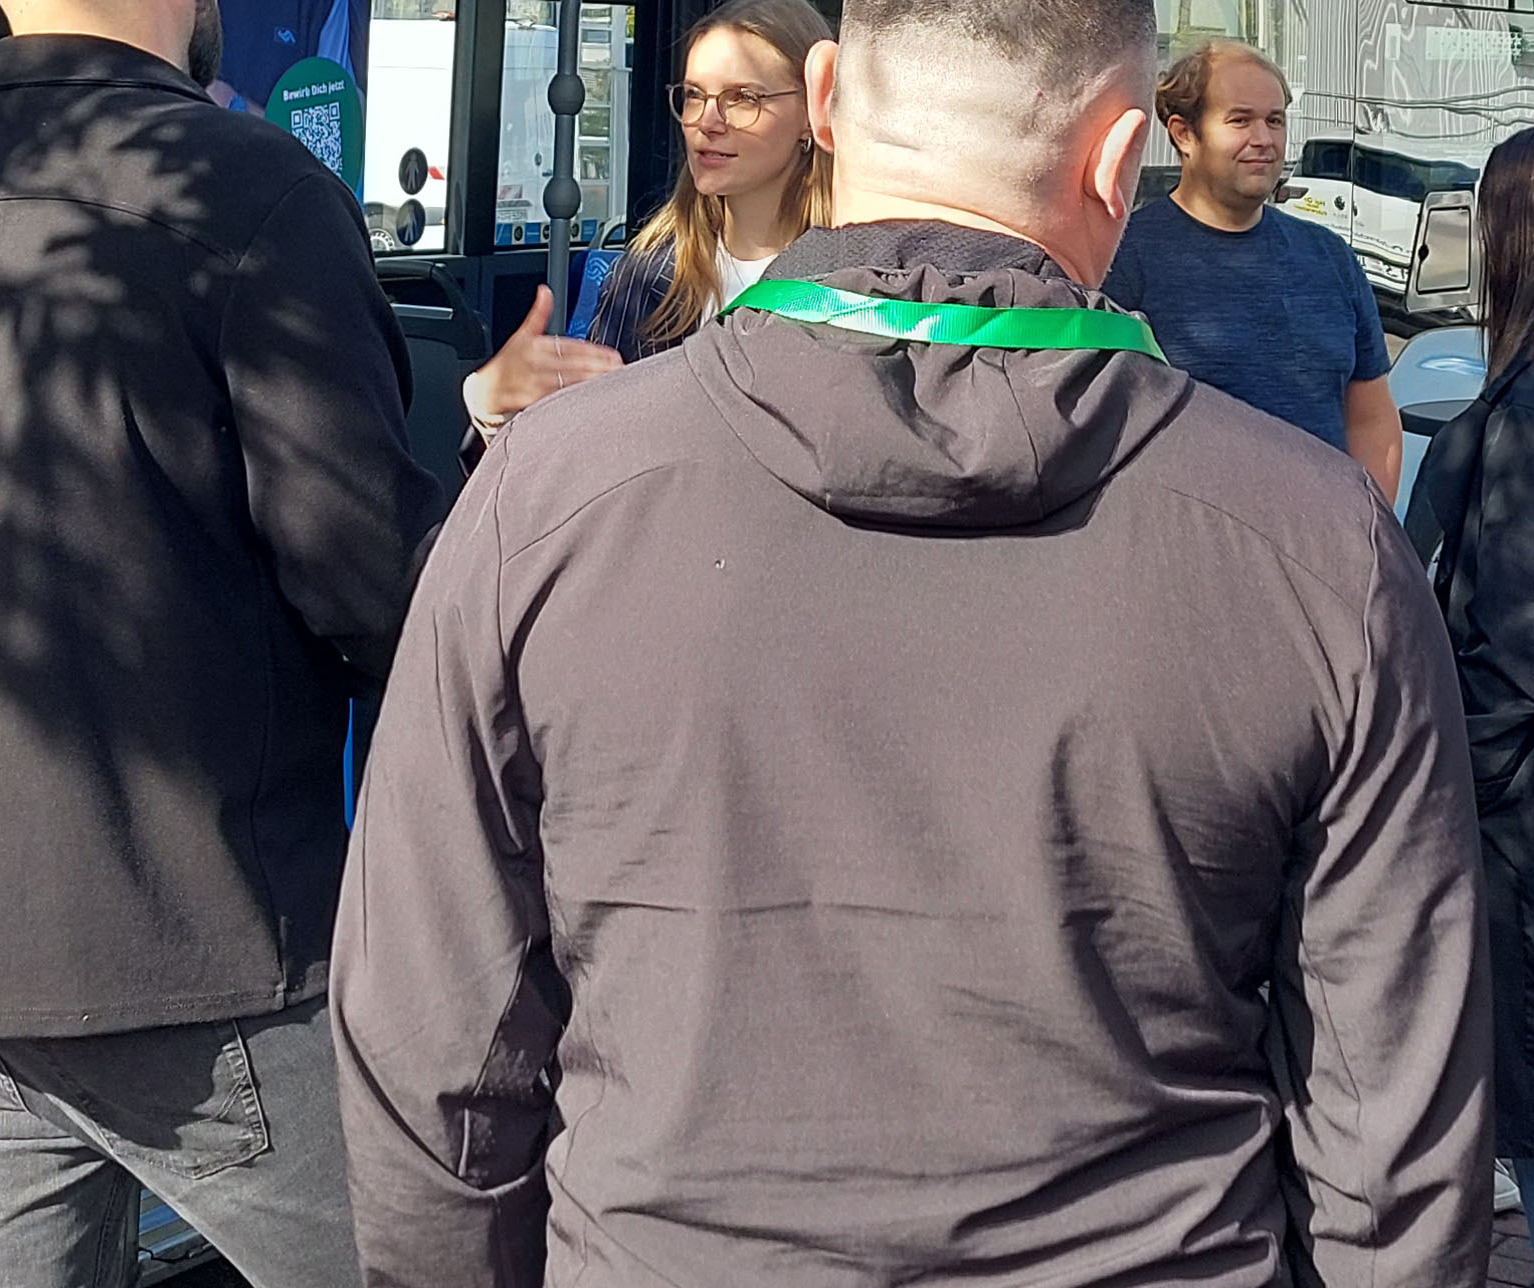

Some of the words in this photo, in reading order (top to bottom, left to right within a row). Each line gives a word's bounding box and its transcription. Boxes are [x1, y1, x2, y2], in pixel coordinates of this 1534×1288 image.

[283, 86, 311, 102] Bewirb
[311, 82, 327, 96] Dich
[328, 79, 345, 95] jetzt
